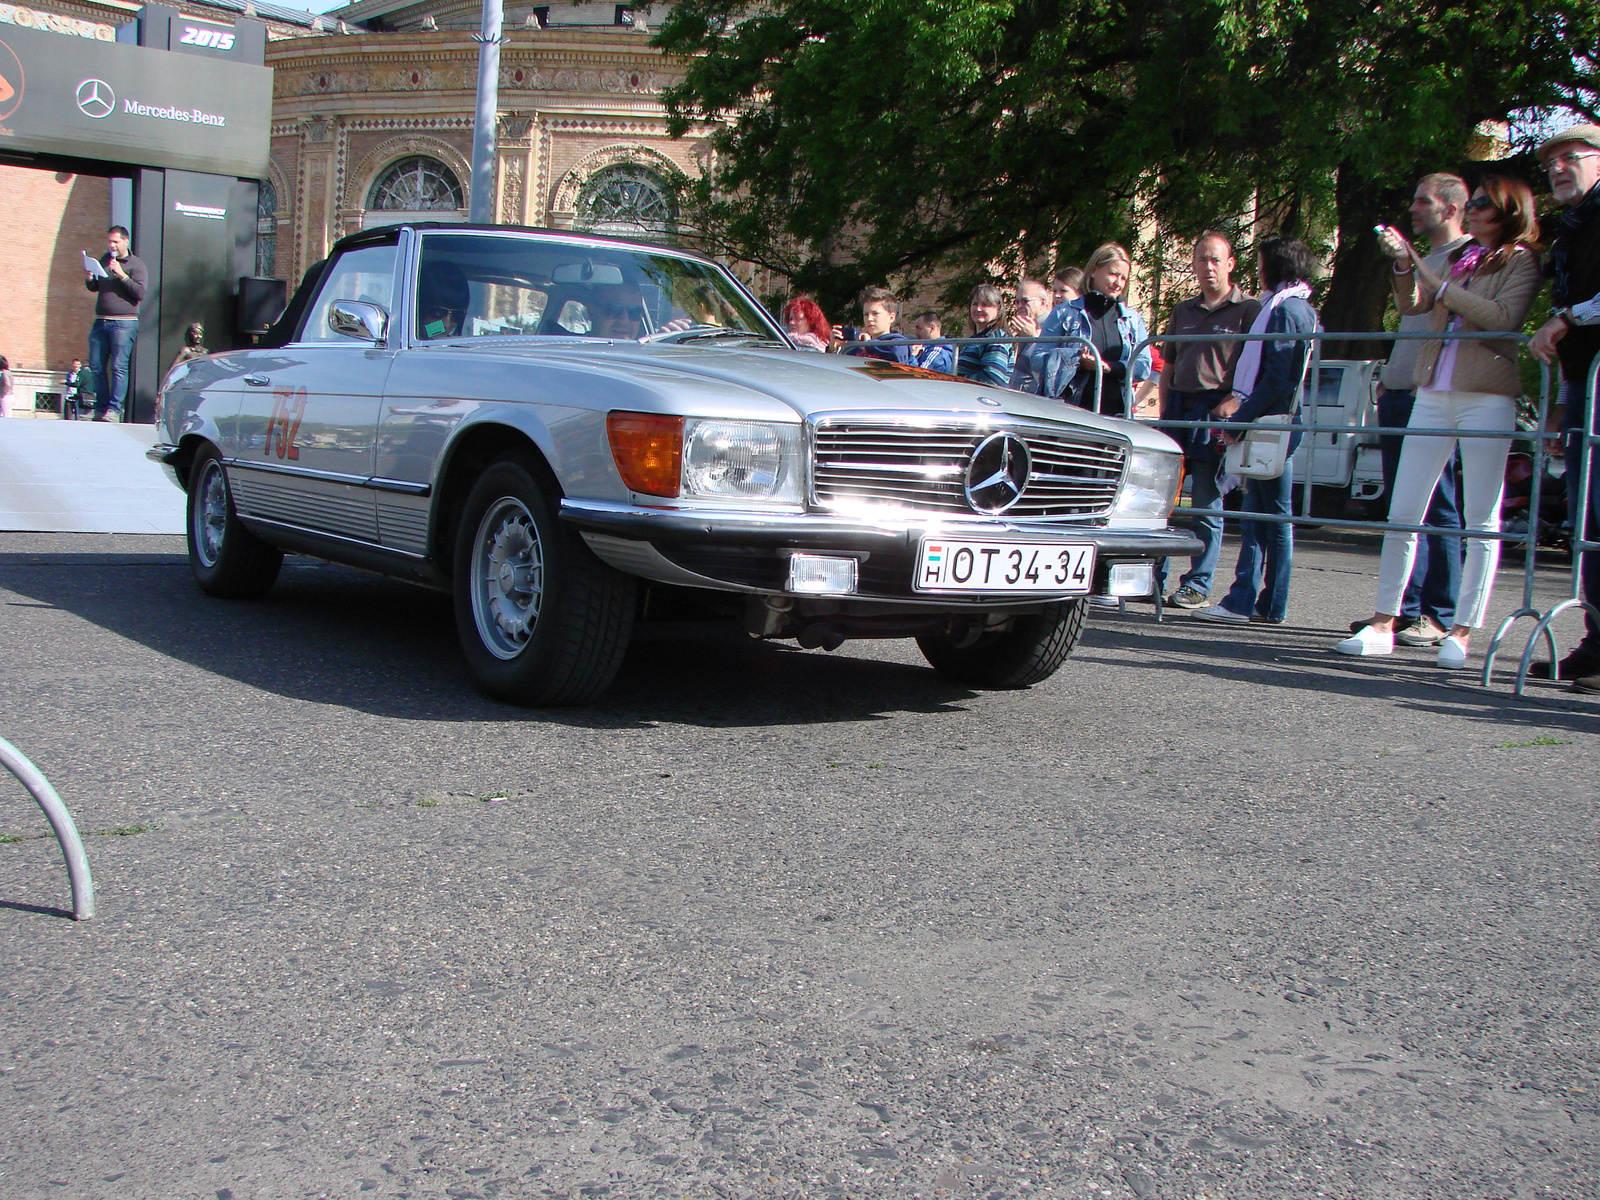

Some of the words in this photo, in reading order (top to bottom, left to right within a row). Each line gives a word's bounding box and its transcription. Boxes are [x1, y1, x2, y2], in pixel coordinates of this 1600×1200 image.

[180, 27, 235, 51] 2015
[124, 100, 226, 127] Mercedes-Benz
[265, 385, 307, 461] 752
[925, 565, 941, 582] H
